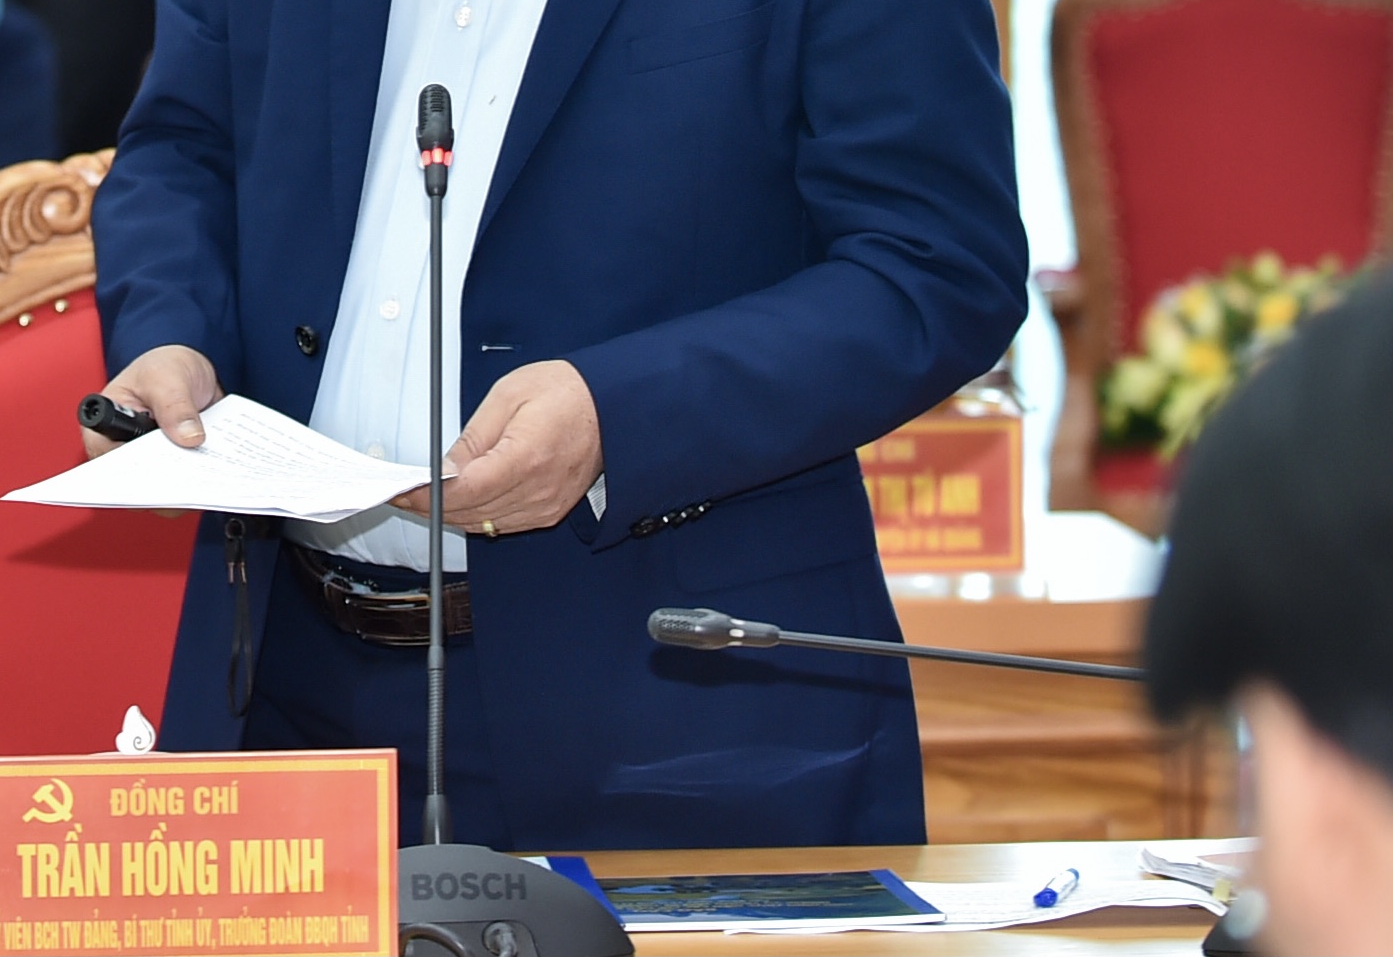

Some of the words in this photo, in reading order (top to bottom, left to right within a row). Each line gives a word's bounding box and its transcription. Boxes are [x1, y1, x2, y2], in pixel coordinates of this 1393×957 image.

[110, 779, 185, 816] ĐỒNG
[193, 781, 239, 815] CHÍ
[17, 823, 110, 898] TRẦN
[121, 822, 218, 896] HỒNG
[230, 838, 324, 894] MINH
[411, 872, 527, 901] BOSCH
[4, 916, 32, 950] VIÊN
[35, 921, 59, 949] BCH
[61, 921, 82, 949] TW
[84, 908, 122, 951] ĐẢNG,
[124, 914, 138, 948] BÍ
[139, 916, 165, 948] THƯ
[165, 908, 193, 948] TỈNH
[268, 911, 303, 945] ĐOÀN
[340, 905, 369, 944] TỈNH
